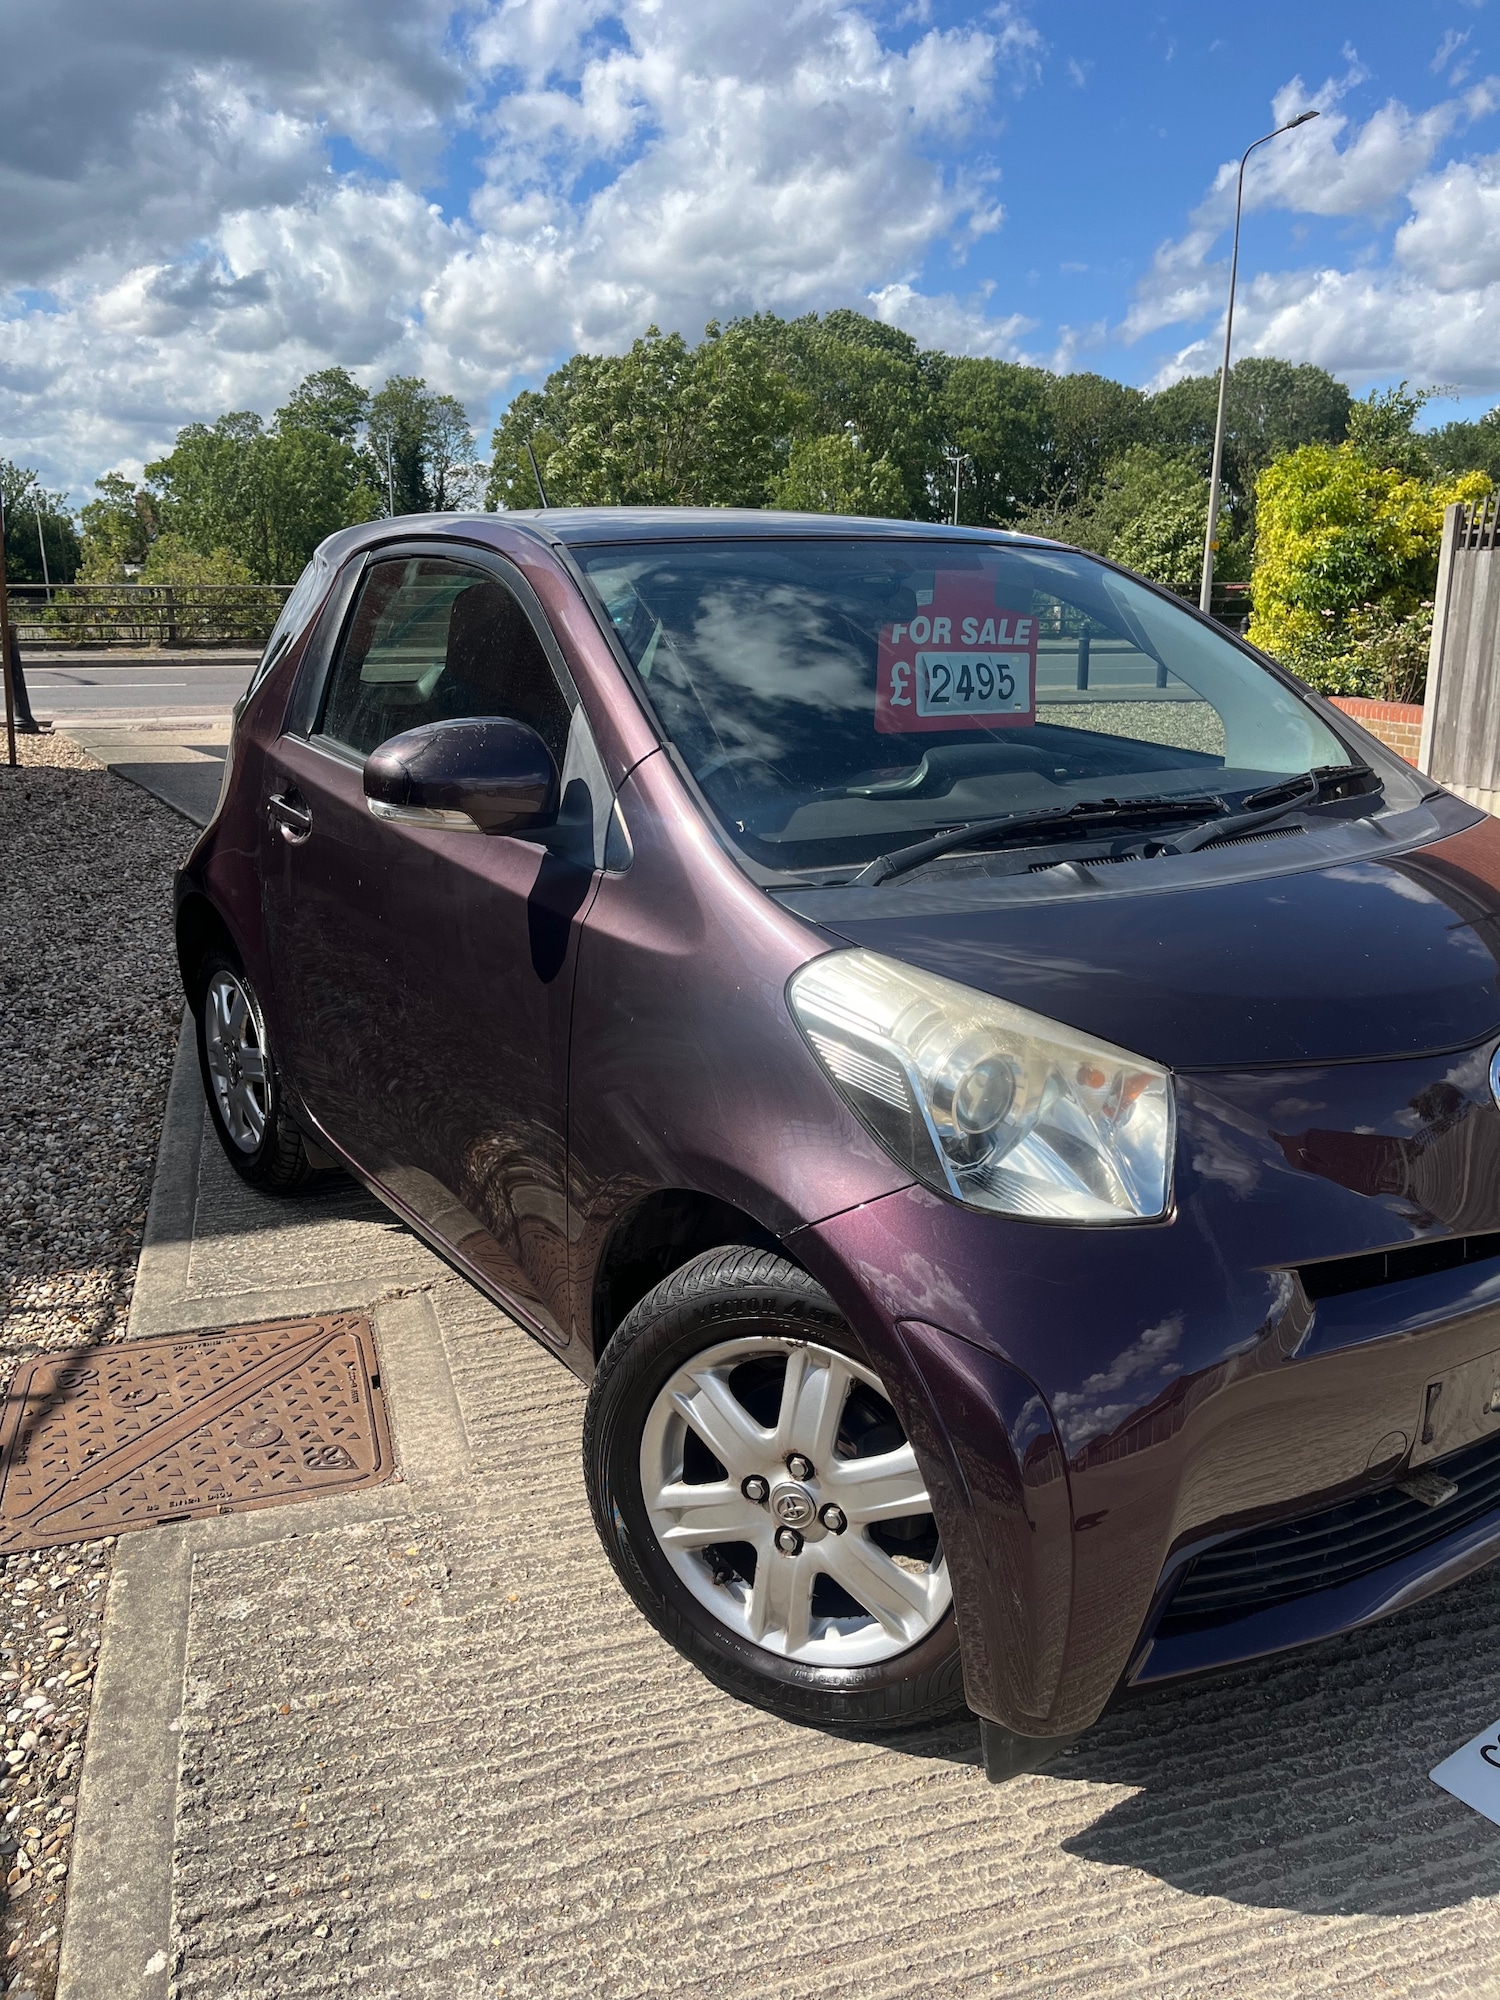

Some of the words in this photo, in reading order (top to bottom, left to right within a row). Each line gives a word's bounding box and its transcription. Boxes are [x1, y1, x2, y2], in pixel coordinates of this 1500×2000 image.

[891, 615, 951, 645] FOR
[960, 616, 1033, 645] SALE
[930, 663, 1015, 703] 2495
[693, 1298, 777, 1322] VECTOR
